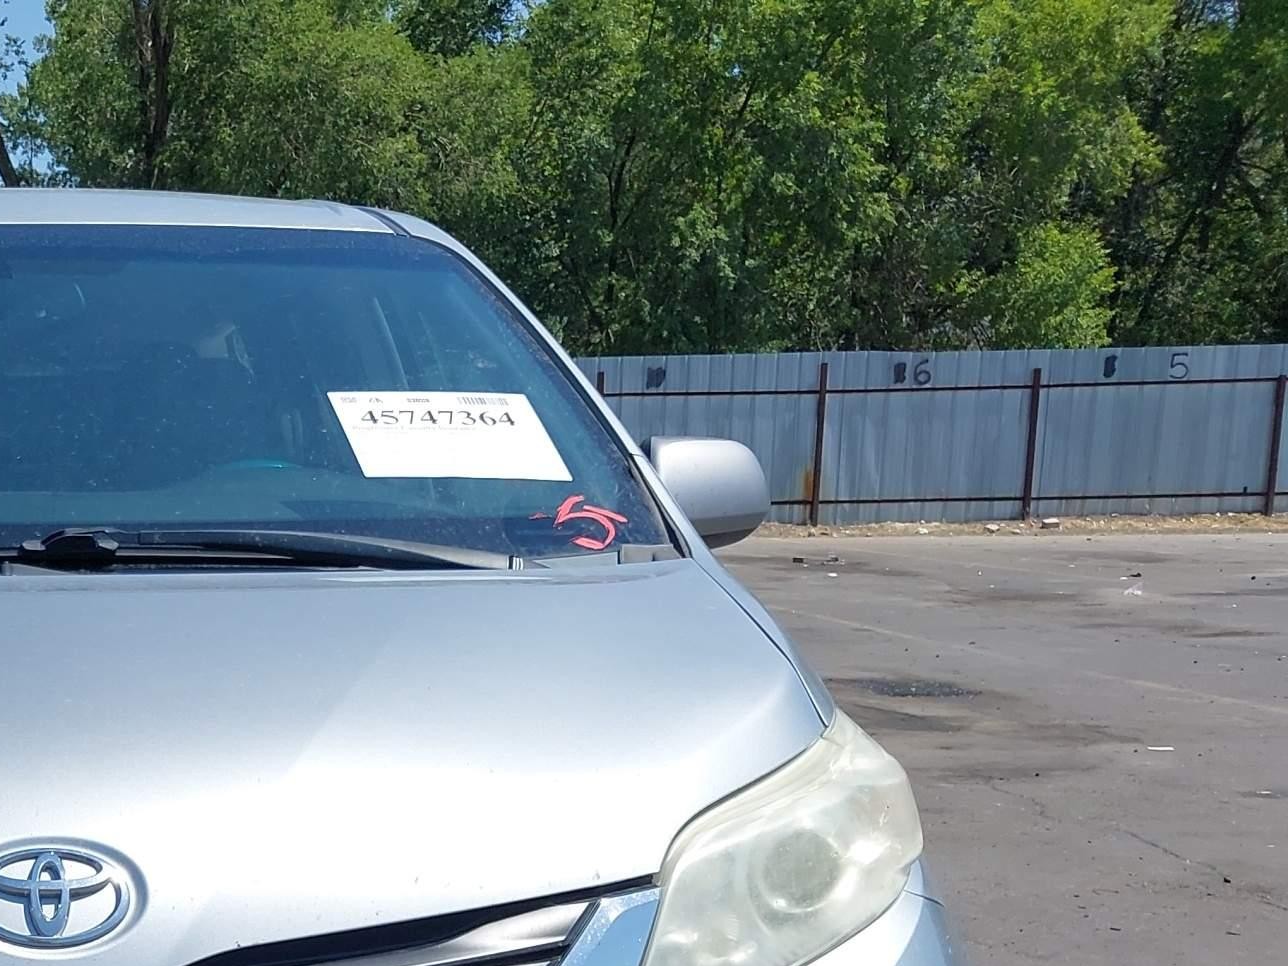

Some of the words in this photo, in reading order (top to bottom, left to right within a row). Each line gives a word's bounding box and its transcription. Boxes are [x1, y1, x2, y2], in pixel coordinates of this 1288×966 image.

[913, 358, 931, 386] 6
[1169, 352, 1189, 379] 5
[361, 409, 516, 427] 45747364
